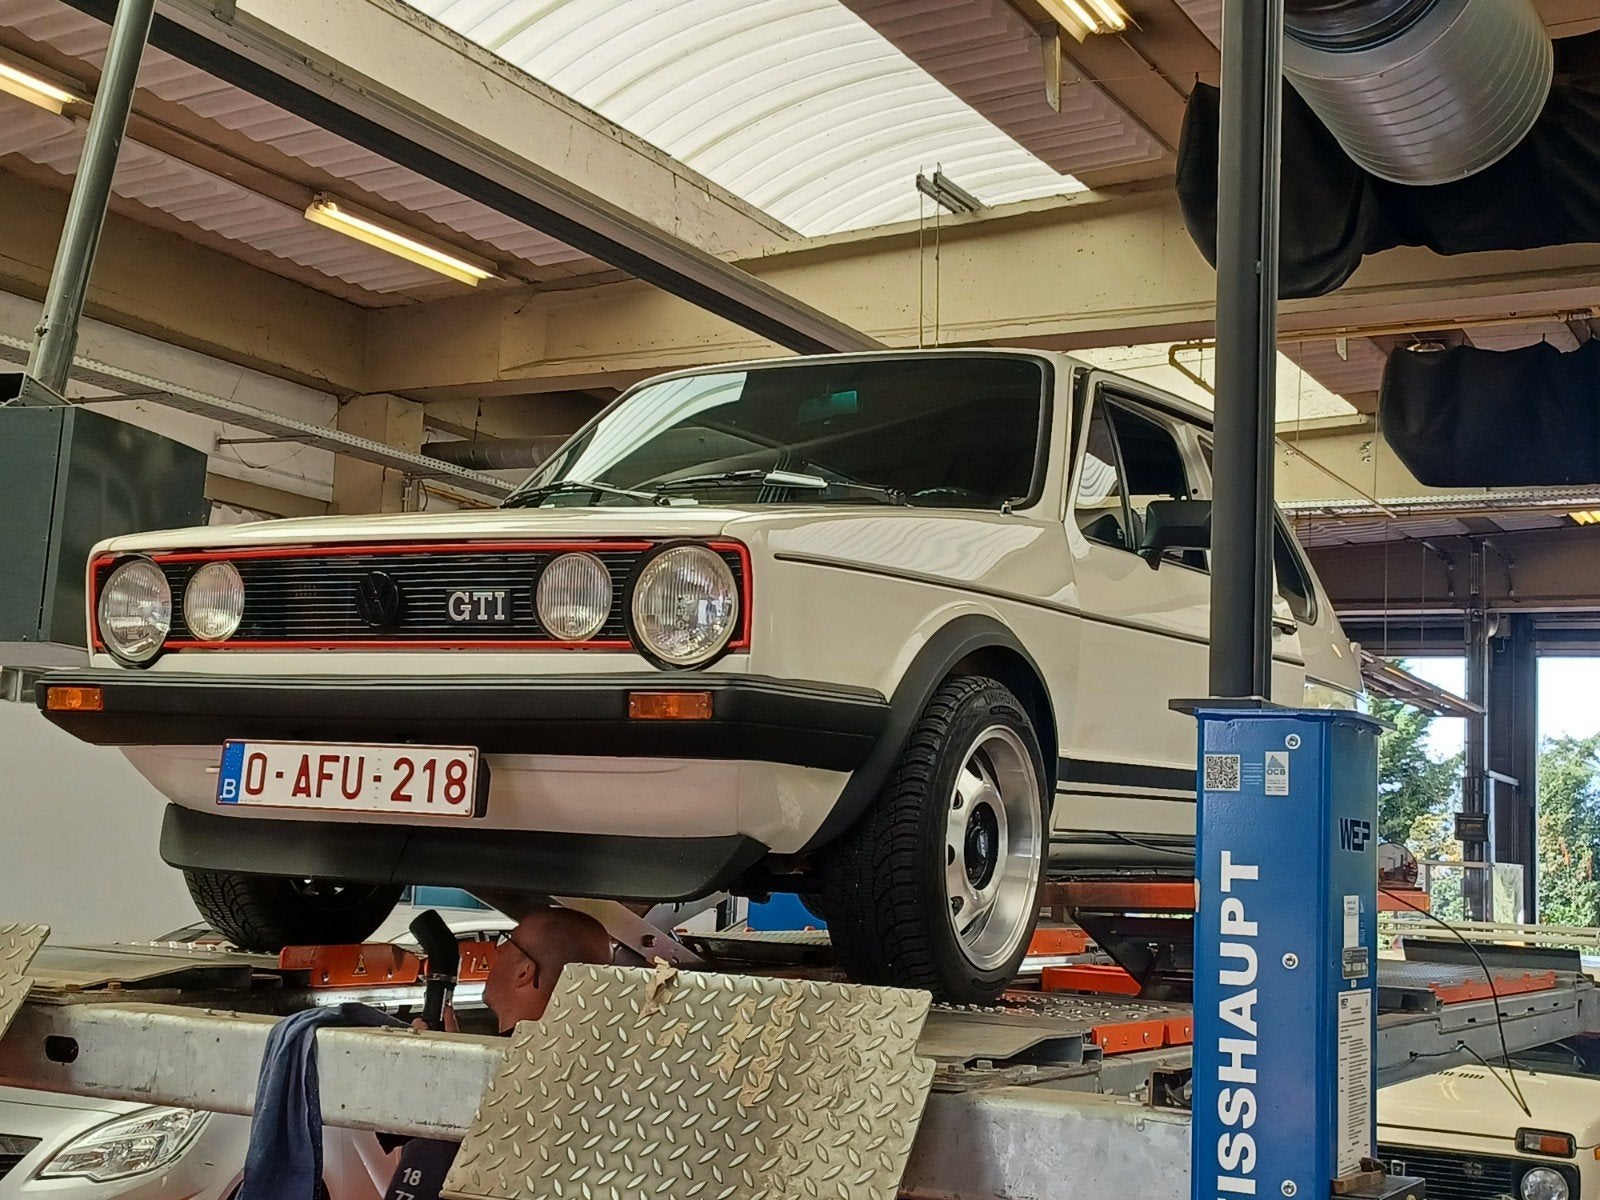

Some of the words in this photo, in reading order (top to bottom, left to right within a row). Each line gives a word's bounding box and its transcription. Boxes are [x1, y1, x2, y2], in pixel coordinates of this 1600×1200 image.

[448, 591, 505, 621] GTI
[1266, 768, 1286, 776] OCB
[222, 778, 236, 798] B
[1217, 850, 1258, 1200] ISSHAUPT
[403, 1167, 422, 1186] 18
